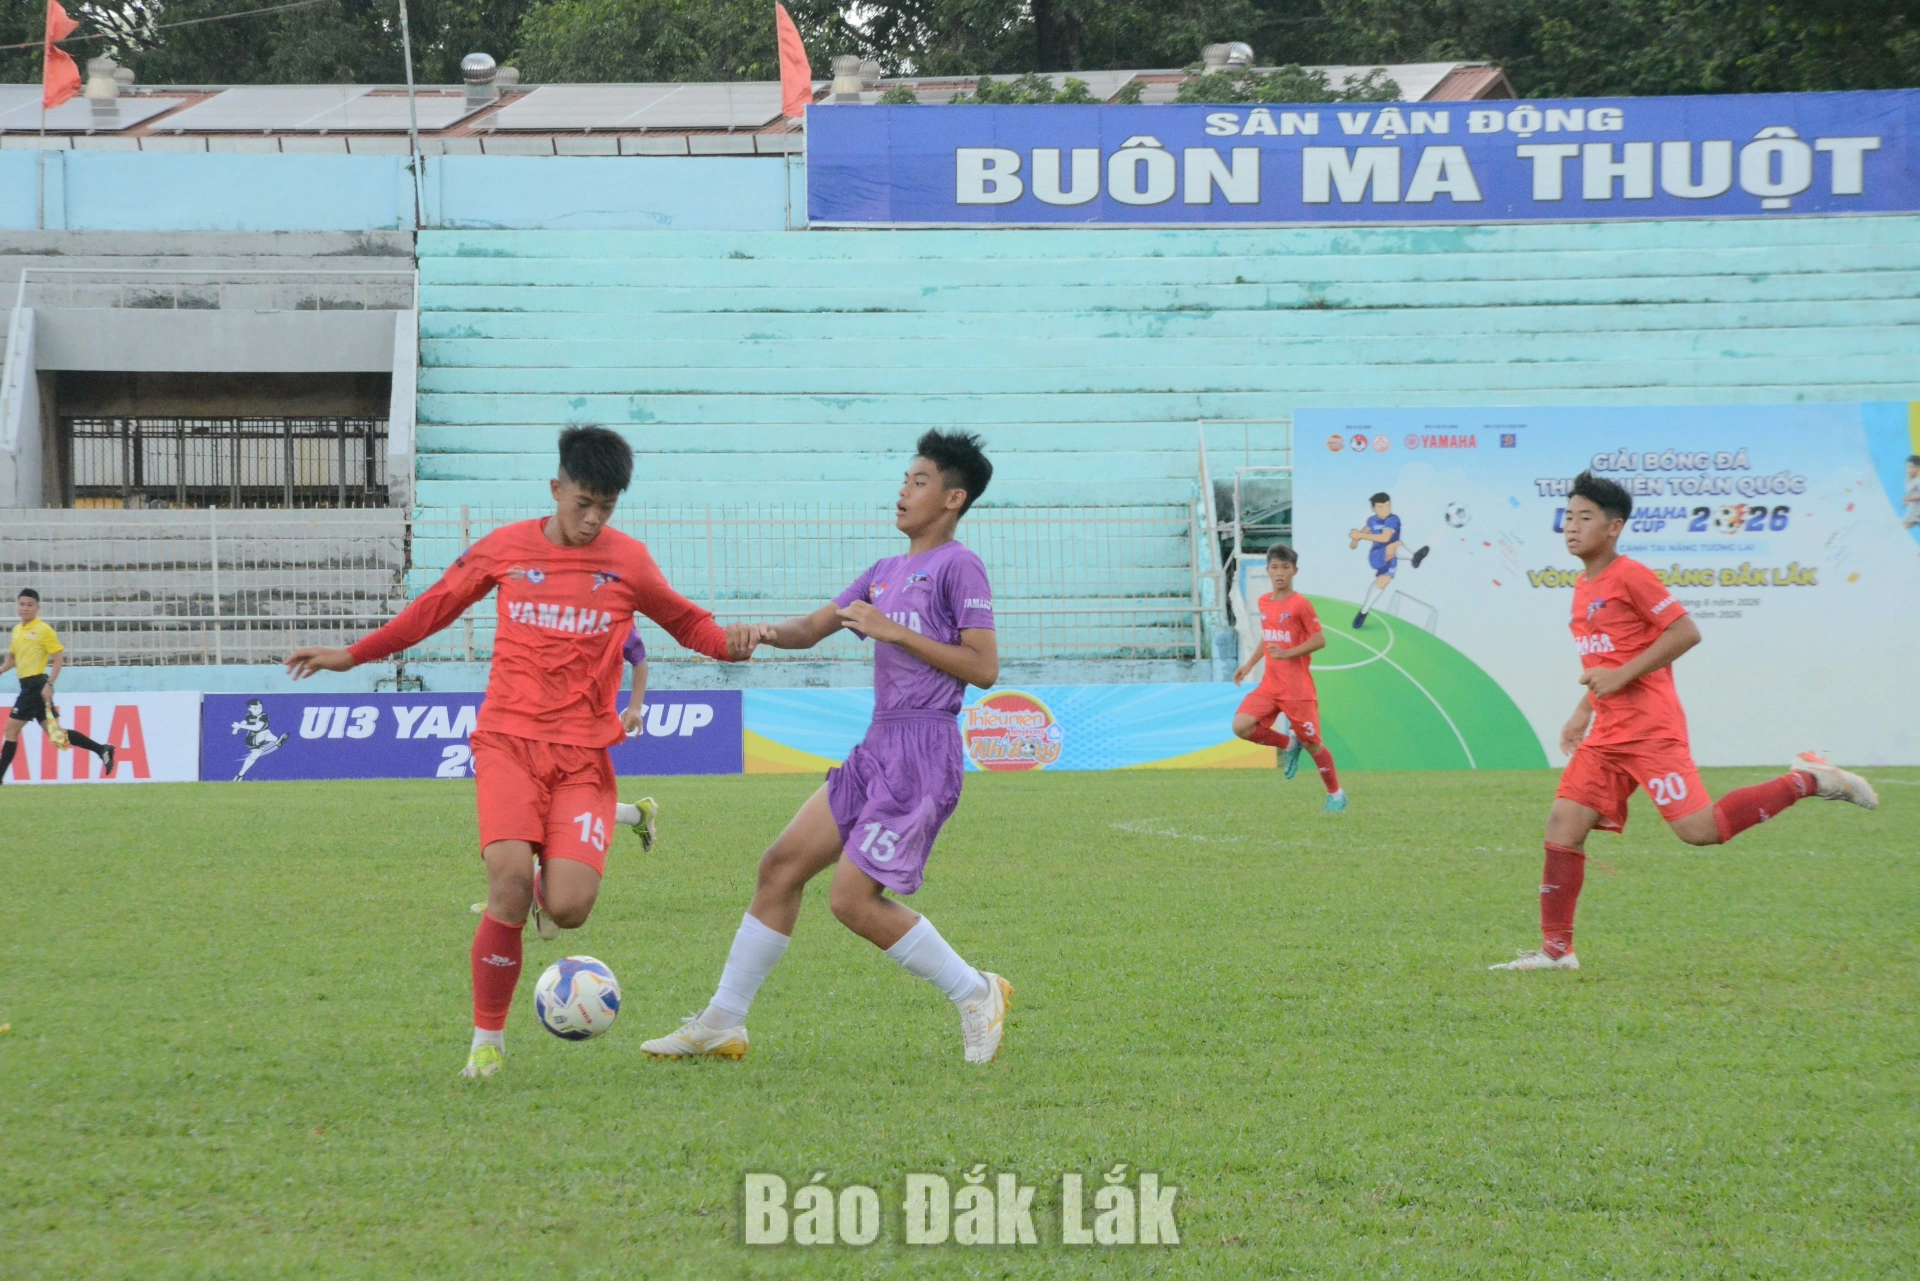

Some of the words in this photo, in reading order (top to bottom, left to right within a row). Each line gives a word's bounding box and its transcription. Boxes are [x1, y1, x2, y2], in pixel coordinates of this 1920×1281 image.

[1204, 108, 1320, 137] SÂN
[1336, 107, 1450, 140] VẬN
[1467, 104, 1624, 138] ĐỘNG
[955, 135, 1261, 206] BUÔN
[1302, 145, 1483, 205] MA
[1516, 125, 1881, 210] THUỘT
[1421, 433, 1477, 449] YAMAHA
[1591, 447, 1638, 472] GIẢI
[1642, 448, 1711, 472] BÓNG
[1713, 446, 1751, 472] ĐÁ
[1666, 472, 1733, 496] TOÀN
[1736, 470, 1807, 499] QUỐC
[1631, 520, 1667, 533] CUP
[1527, 565, 1579, 588] VÒN
[1772, 561, 1818, 587] LẮK
[508, 601, 612, 635] YAMAHA
[299, 706, 381, 739] U13
[1303, 722, 1316, 736] 3
[1648, 772, 1687, 806] 20
[573, 811, 605, 852] 15
[859, 822, 901, 862] 15
